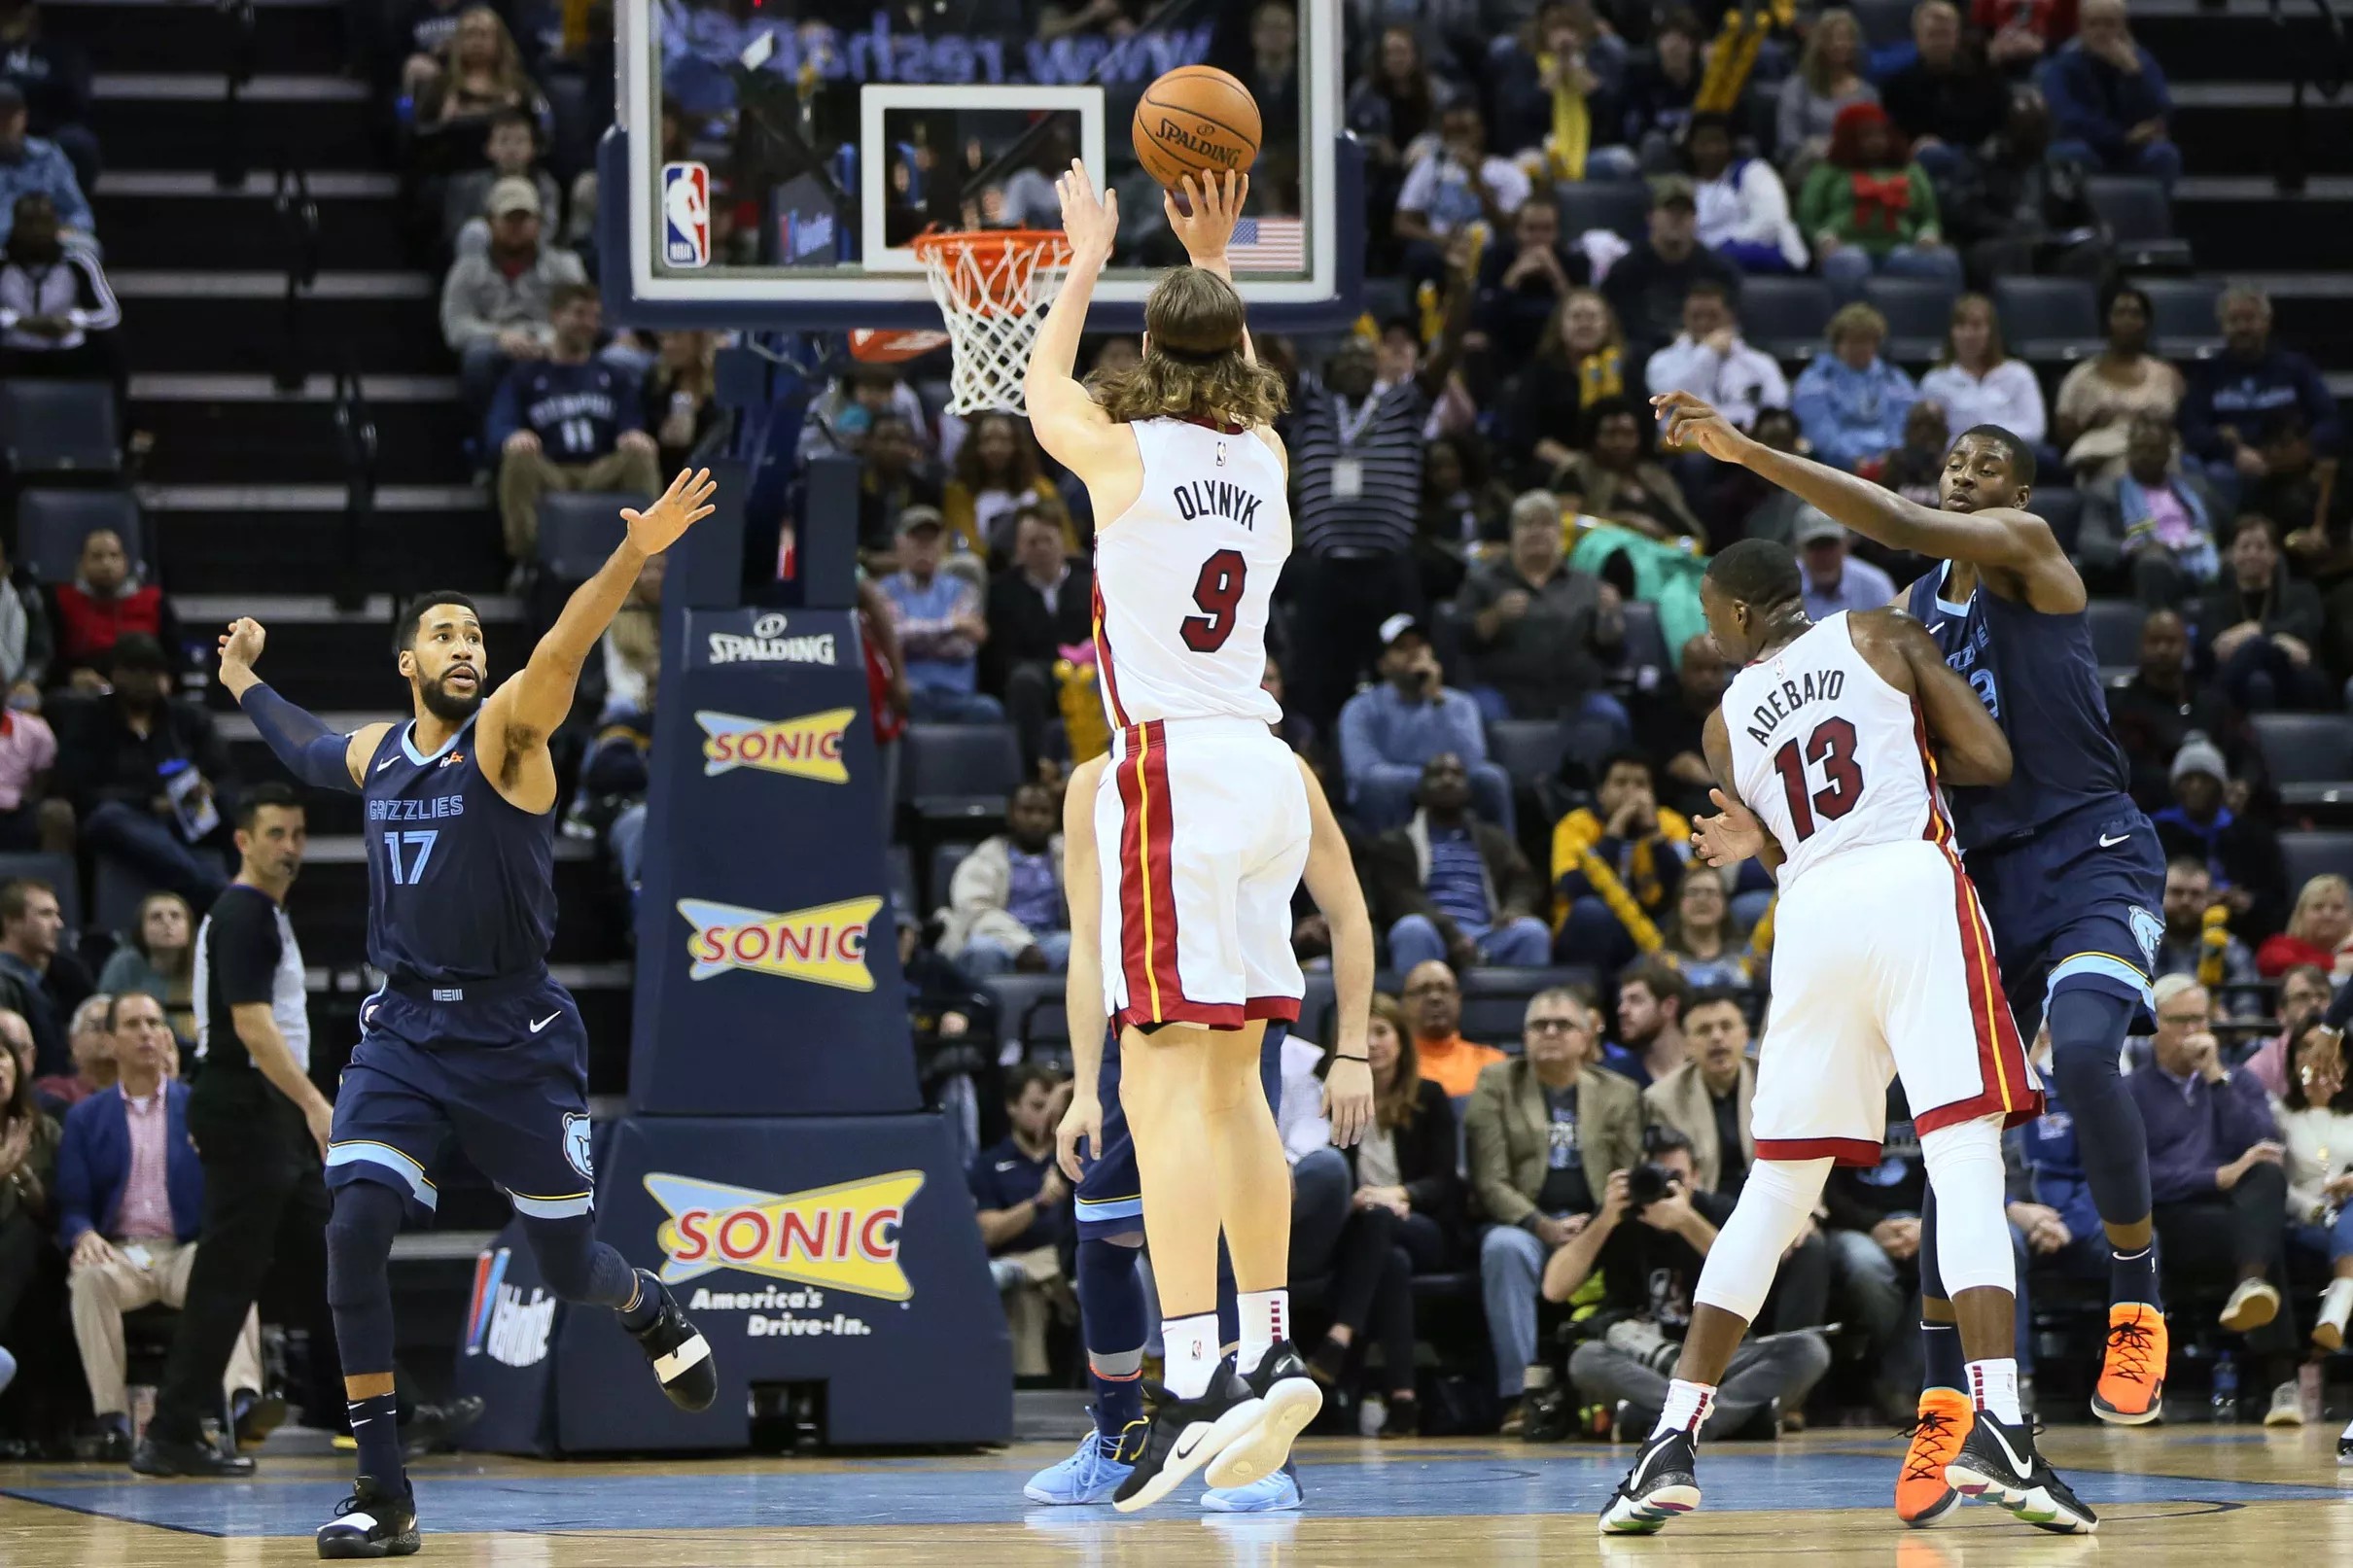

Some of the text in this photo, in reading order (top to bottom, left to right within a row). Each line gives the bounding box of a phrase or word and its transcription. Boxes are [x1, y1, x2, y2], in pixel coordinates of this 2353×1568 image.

[1155, 118, 1241, 168] SPALDING
[1174, 480, 1262, 531] OLYNYK
[1179, 548, 1247, 652] 9
[709, 633, 836, 665] SPALDING
[1746, 670, 1844, 748] ADEBAYO
[715, 731, 842, 762] SONIC
[1774, 715, 1865, 843] 13
[369, 795, 464, 819] GRIZZLIES
[384, 830, 439, 884] 17
[701, 924, 867, 963] SONIC
[671, 1207, 902, 1261] SONIC
[688, 1284, 824, 1310] America's
[747, 1311, 871, 1337] Drive-In.
